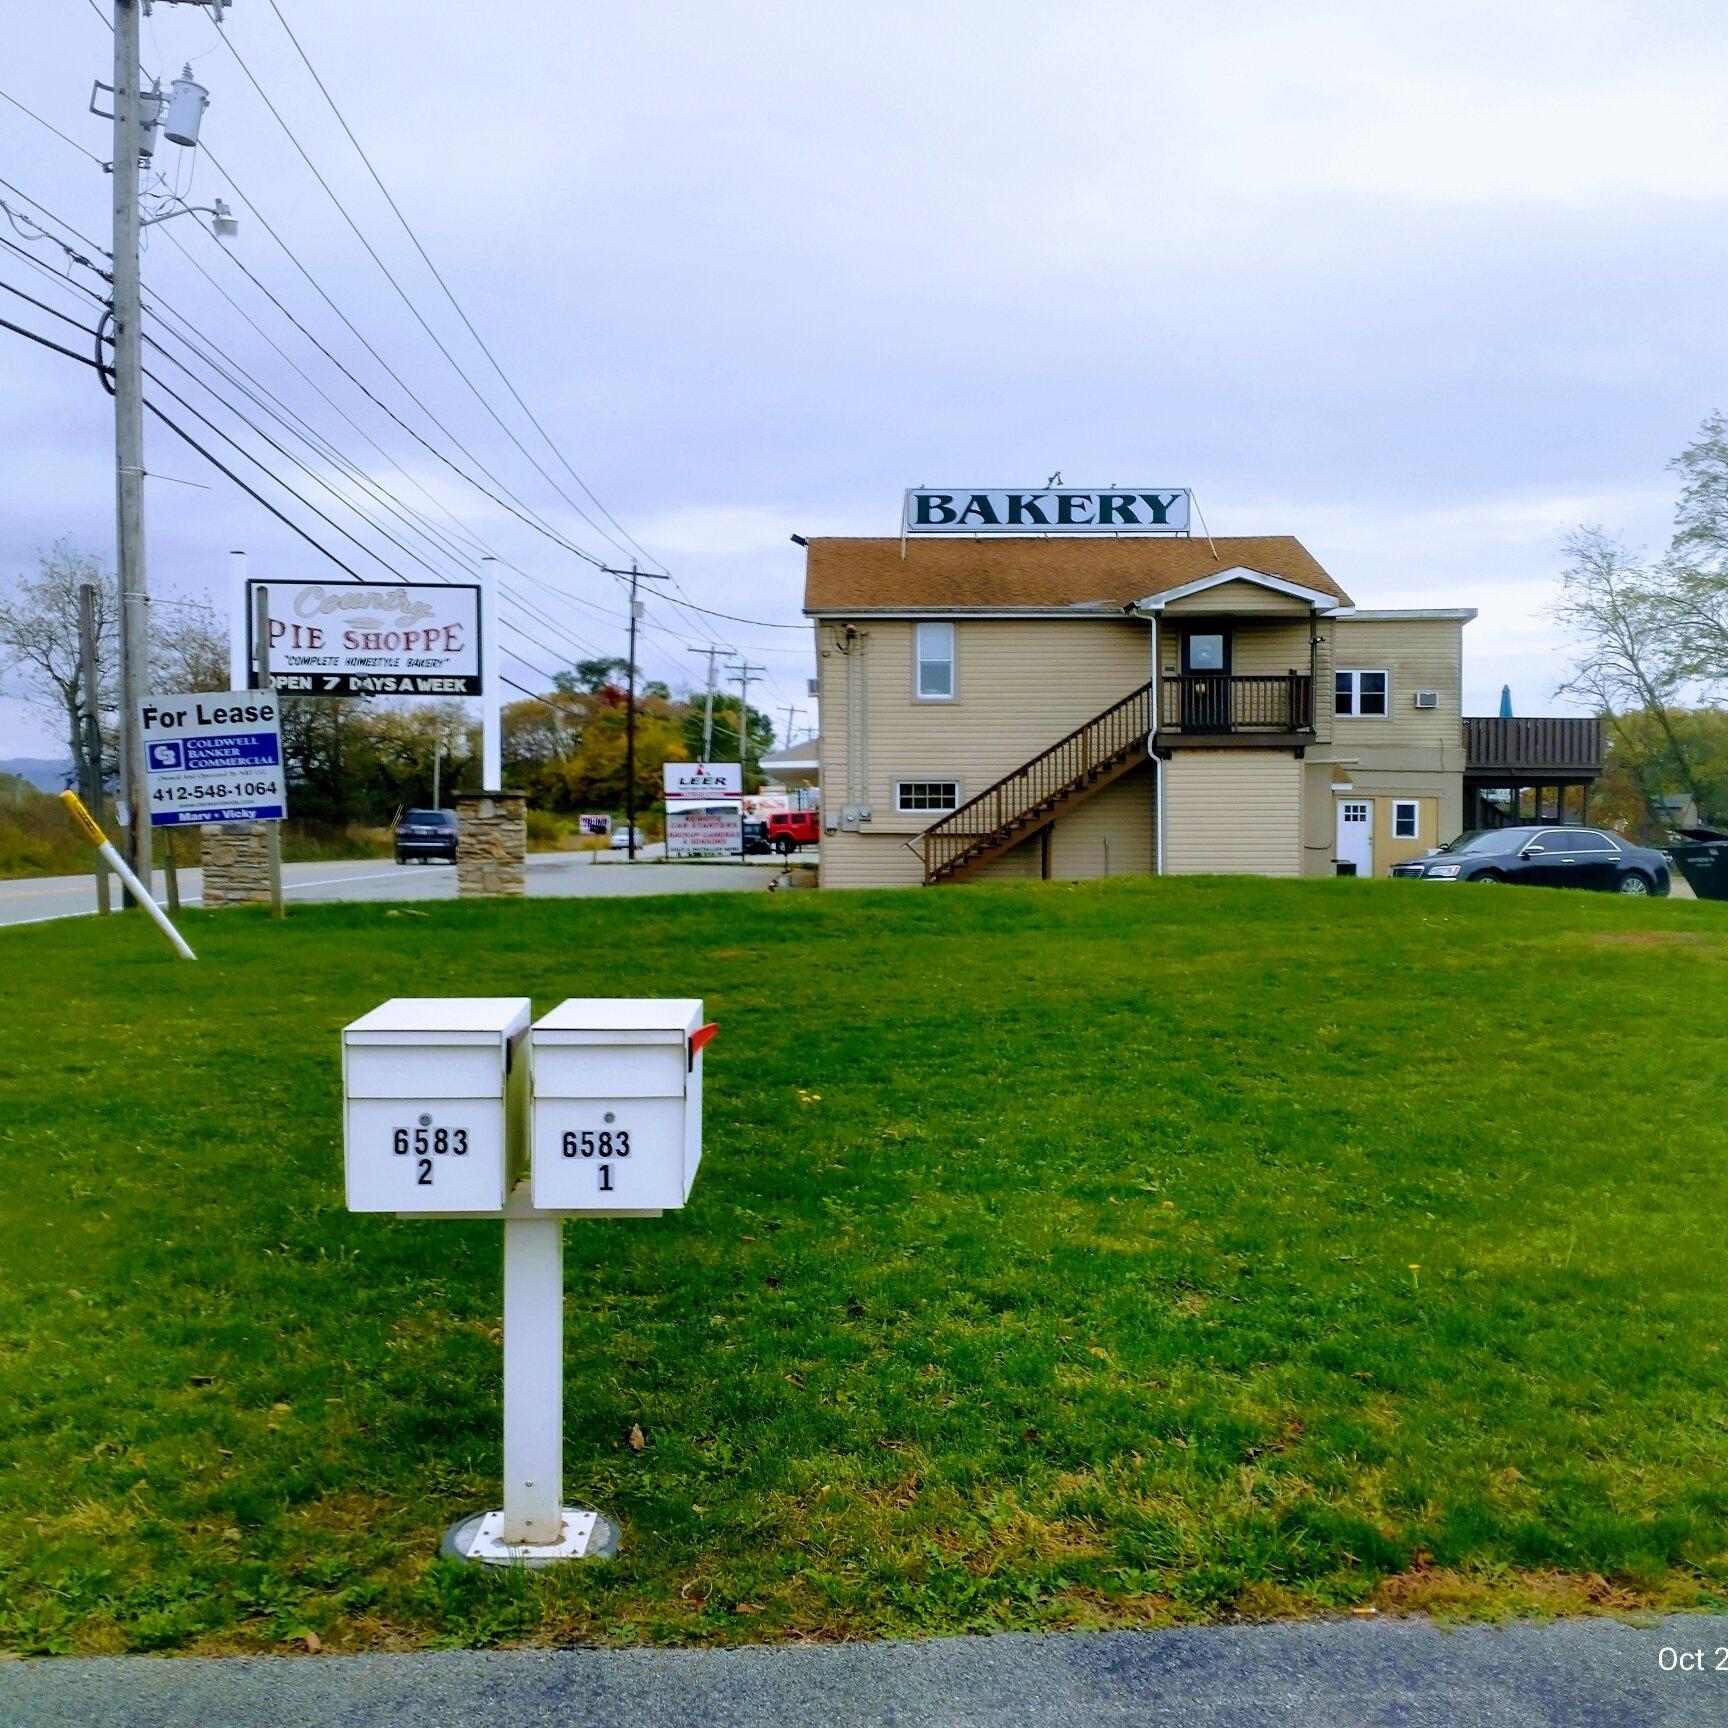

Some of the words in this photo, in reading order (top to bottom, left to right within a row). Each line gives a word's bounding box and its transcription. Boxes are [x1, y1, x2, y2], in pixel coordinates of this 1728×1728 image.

[913, 494, 1182, 525] BAKERY
[293, 586, 435, 628] Country
[268, 618, 327, 649] PIE
[342, 622, 465, 652] SHOPPE
[322, 676, 342, 691] 7
[349, 676, 398, 692] DAYS
[398, 677, 415, 692] A
[416, 677, 467, 693] WEEK
[142, 706, 187, 729] For
[196, 704, 274, 725] Lease
[187, 737, 259, 749] COLDWELL
[188, 748, 240, 758] BANKER
[188, 756, 275, 768] COMMERCIAL
[153, 781, 277, 801] 412-548-1064
[679, 777, 727, 786] LEER
[221, 808, 257, 820] Vicky
[393, 1128, 468, 1155] 6583
[563, 1131, 631, 1158] 6583
[418, 1159, 432, 1184] 2
[599, 1165, 613, 1191] 1
